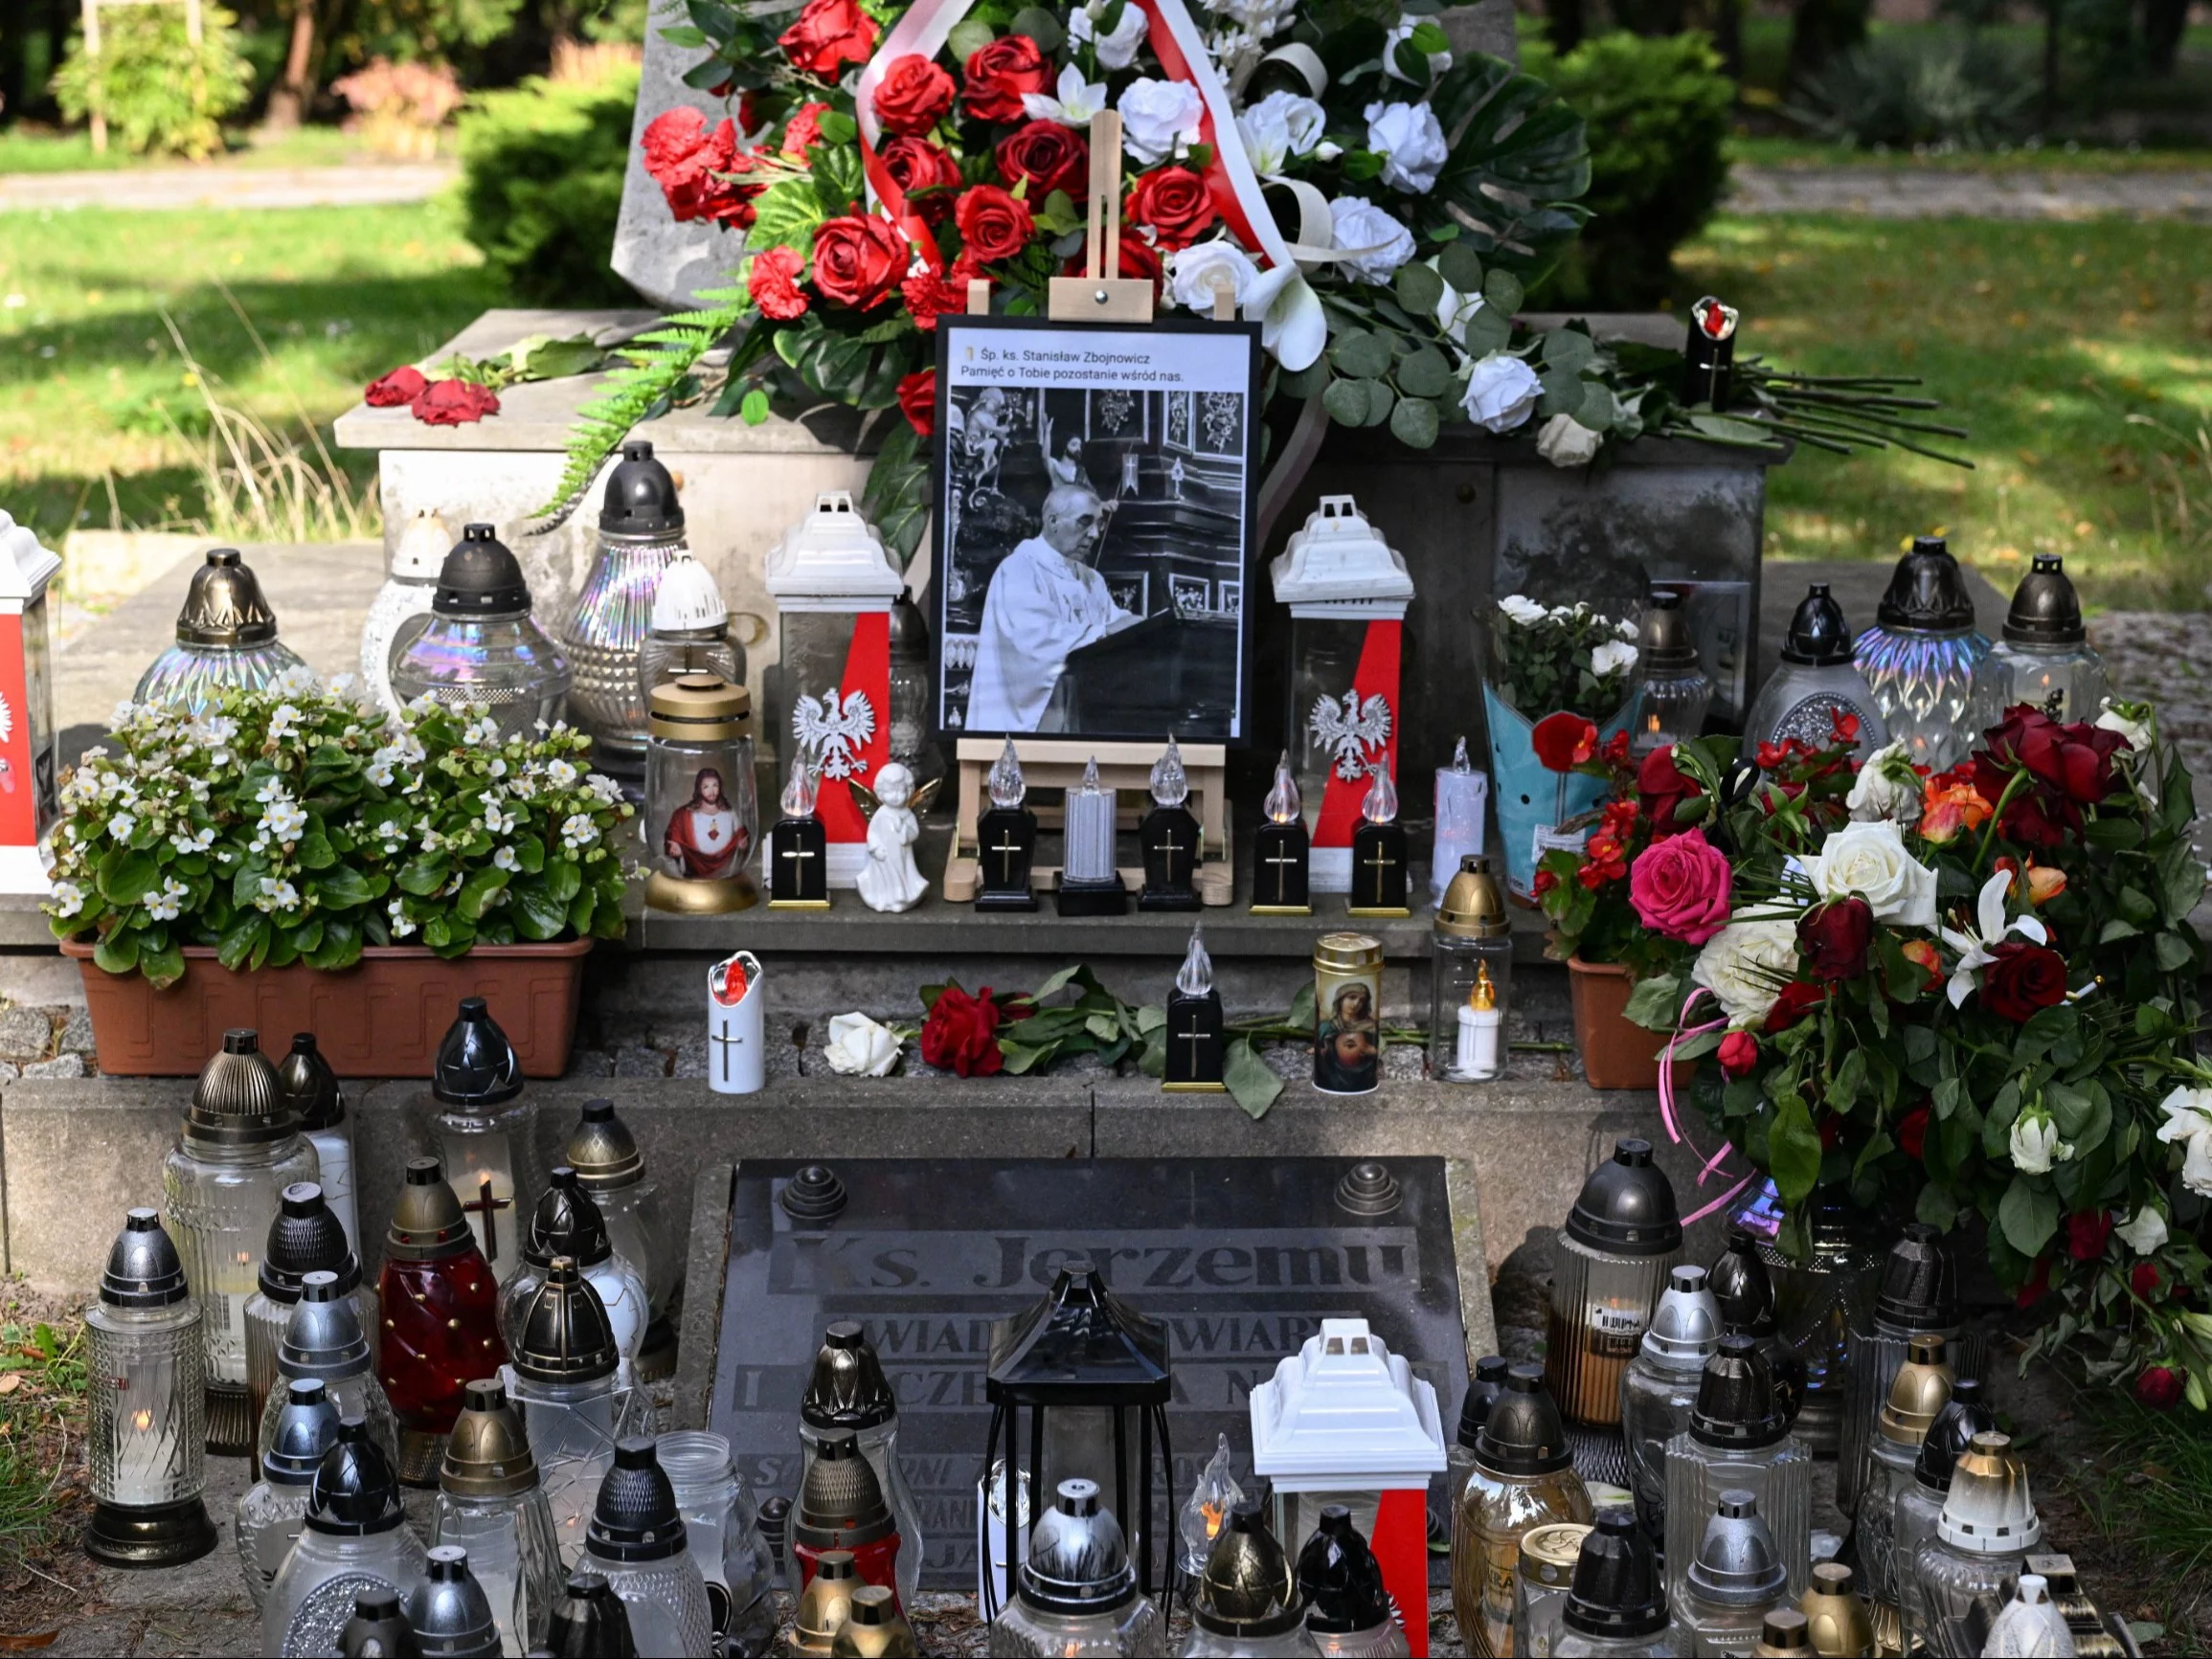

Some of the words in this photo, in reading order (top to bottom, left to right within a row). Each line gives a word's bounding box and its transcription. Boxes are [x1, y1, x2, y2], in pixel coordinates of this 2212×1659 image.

[981, 347, 999, 362] Śp.
[1003, 349, 1019, 362] ks.
[1023, 350, 1080, 363] Stanisław
[1083, 351, 1151, 366] Zbojnowicz
[960, 365, 1004, 379] Pamięć
[1007, 368, 1015, 378] o
[1019, 367, 1050, 379] Tobie
[1052, 370, 1118, 381] pozostanie
[1120, 370, 1157, 382] wśród
[1159, 372, 1185, 383] nas.
[791, 1237, 931, 1288] Ks.
[972, 1236, 1408, 1289] Jerzemu
